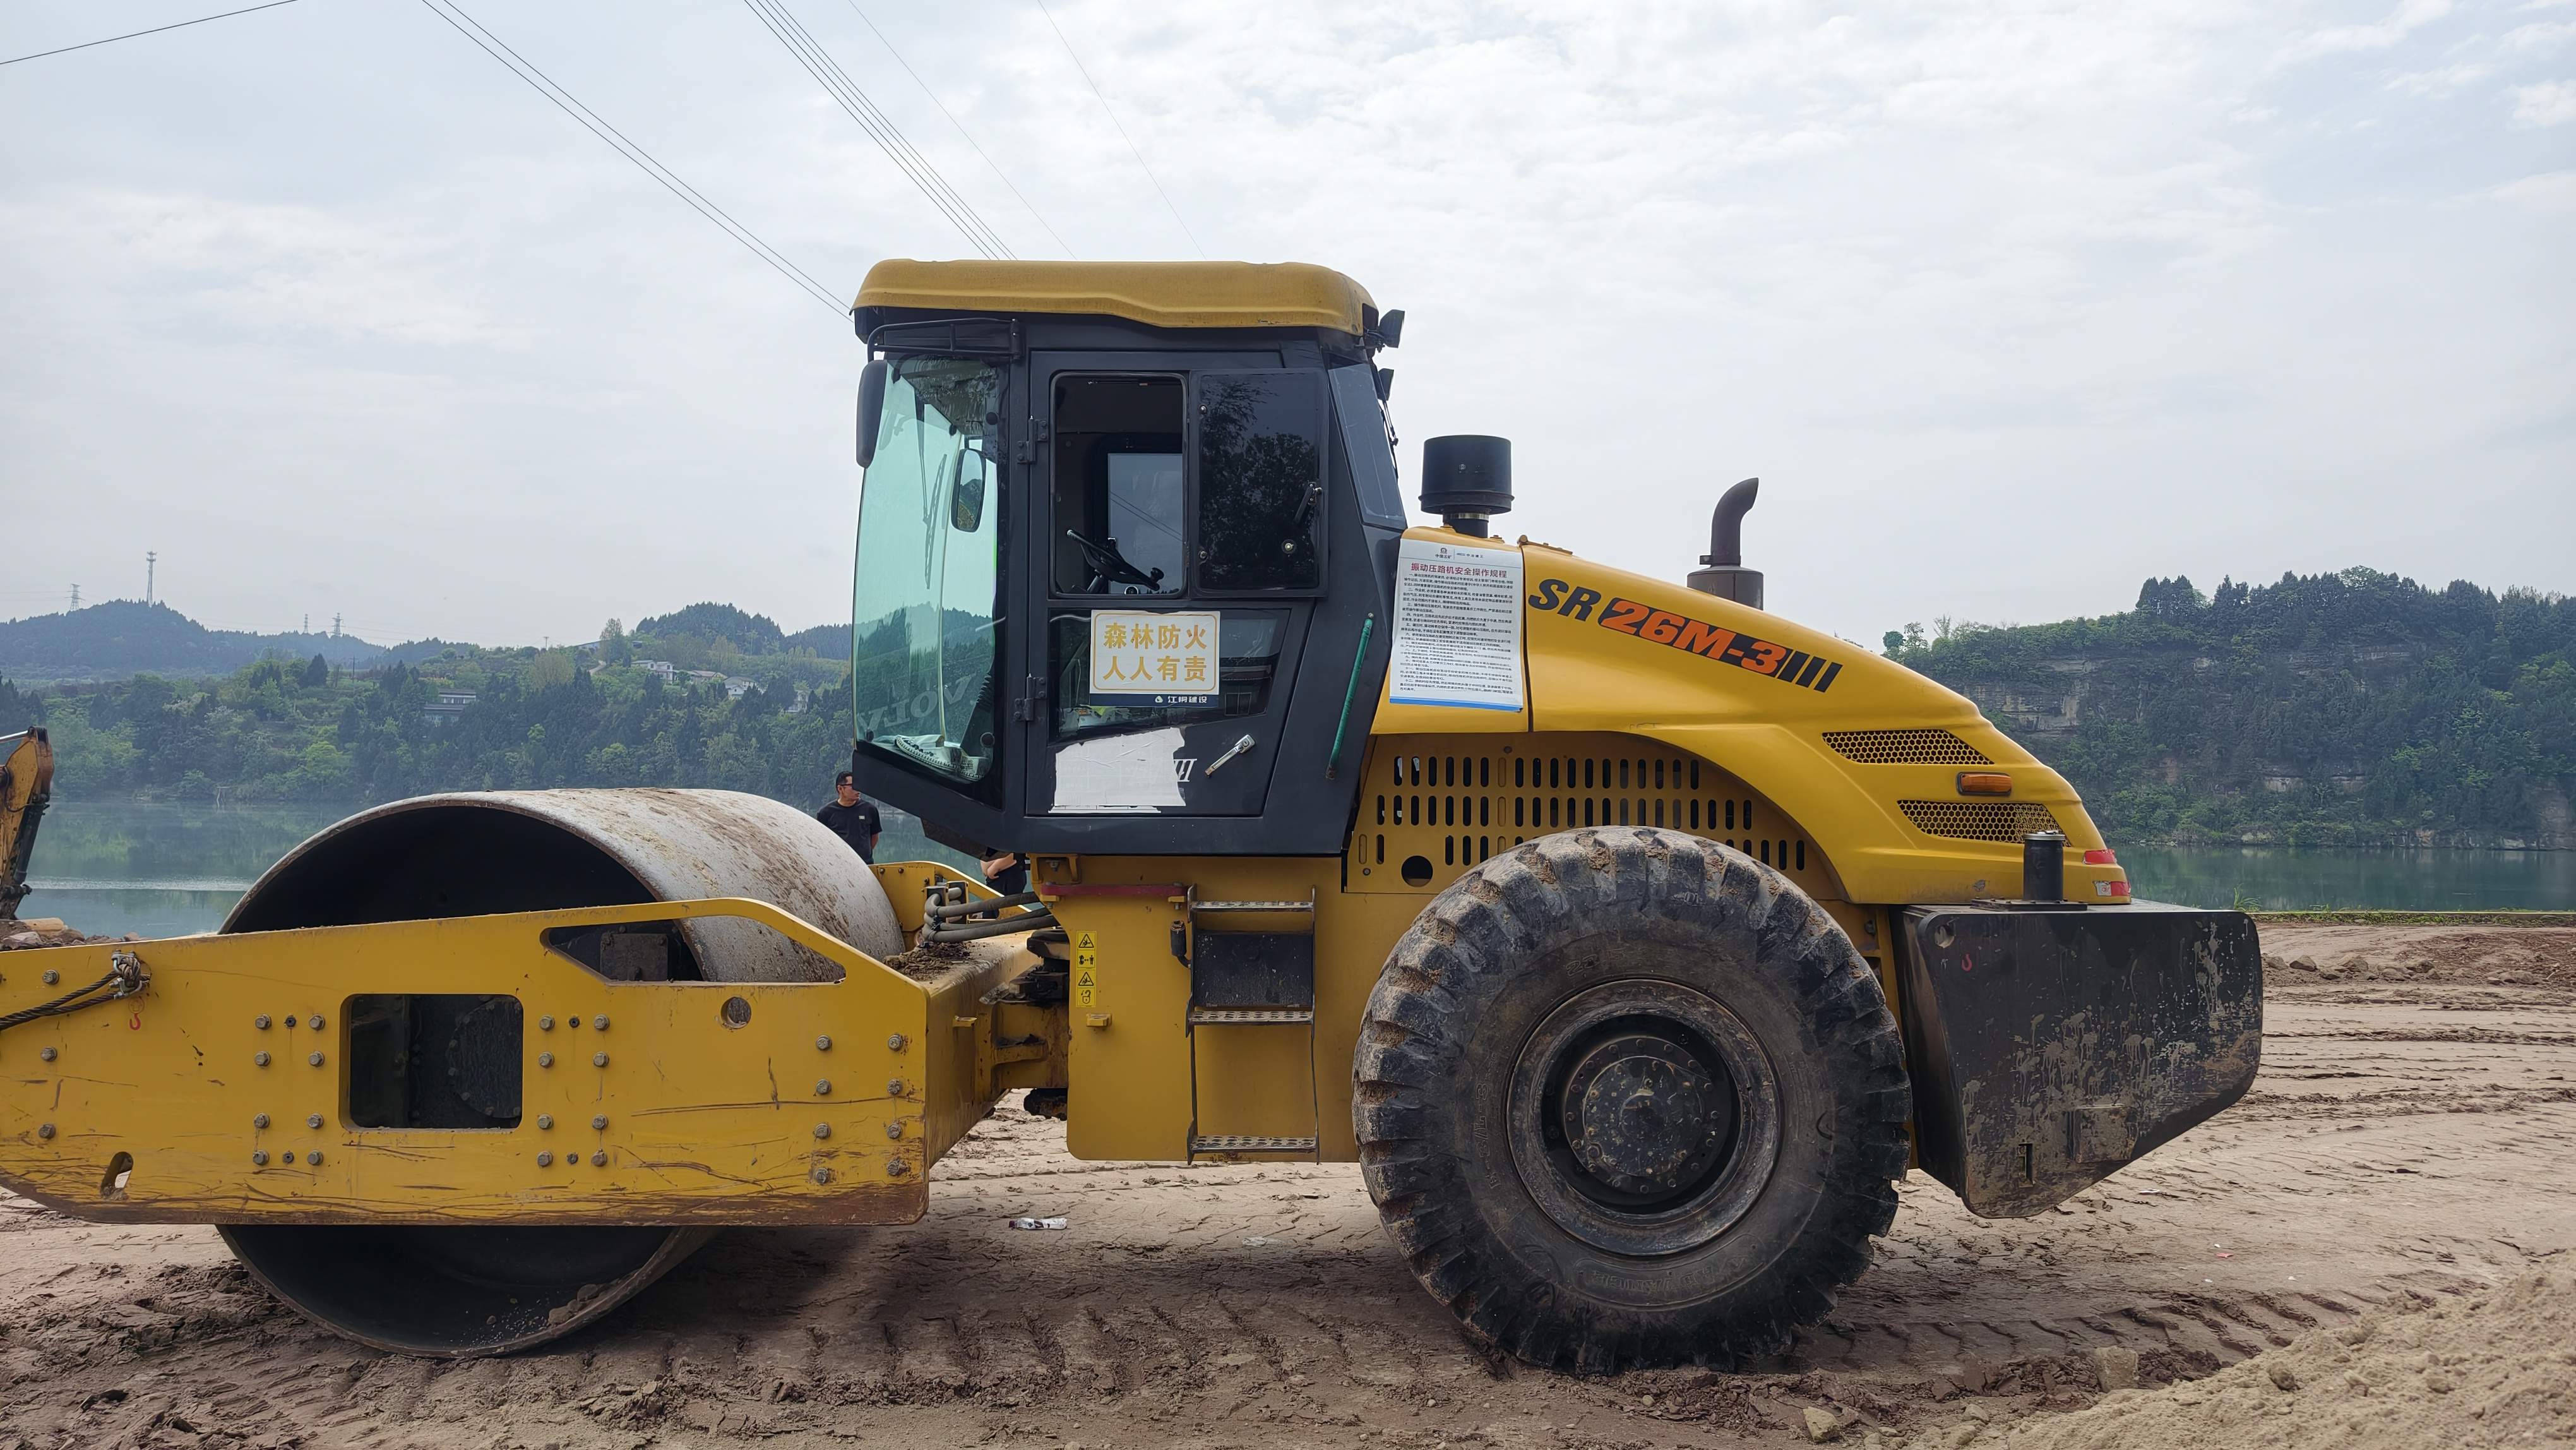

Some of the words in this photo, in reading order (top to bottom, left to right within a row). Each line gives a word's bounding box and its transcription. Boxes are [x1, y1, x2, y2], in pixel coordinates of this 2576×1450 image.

[1410, 562, 1507, 578] 振动压路机安全操作规程
[1103, 622, 1208, 650] 森林防火
[1102, 655, 1207, 683] 人人有责
